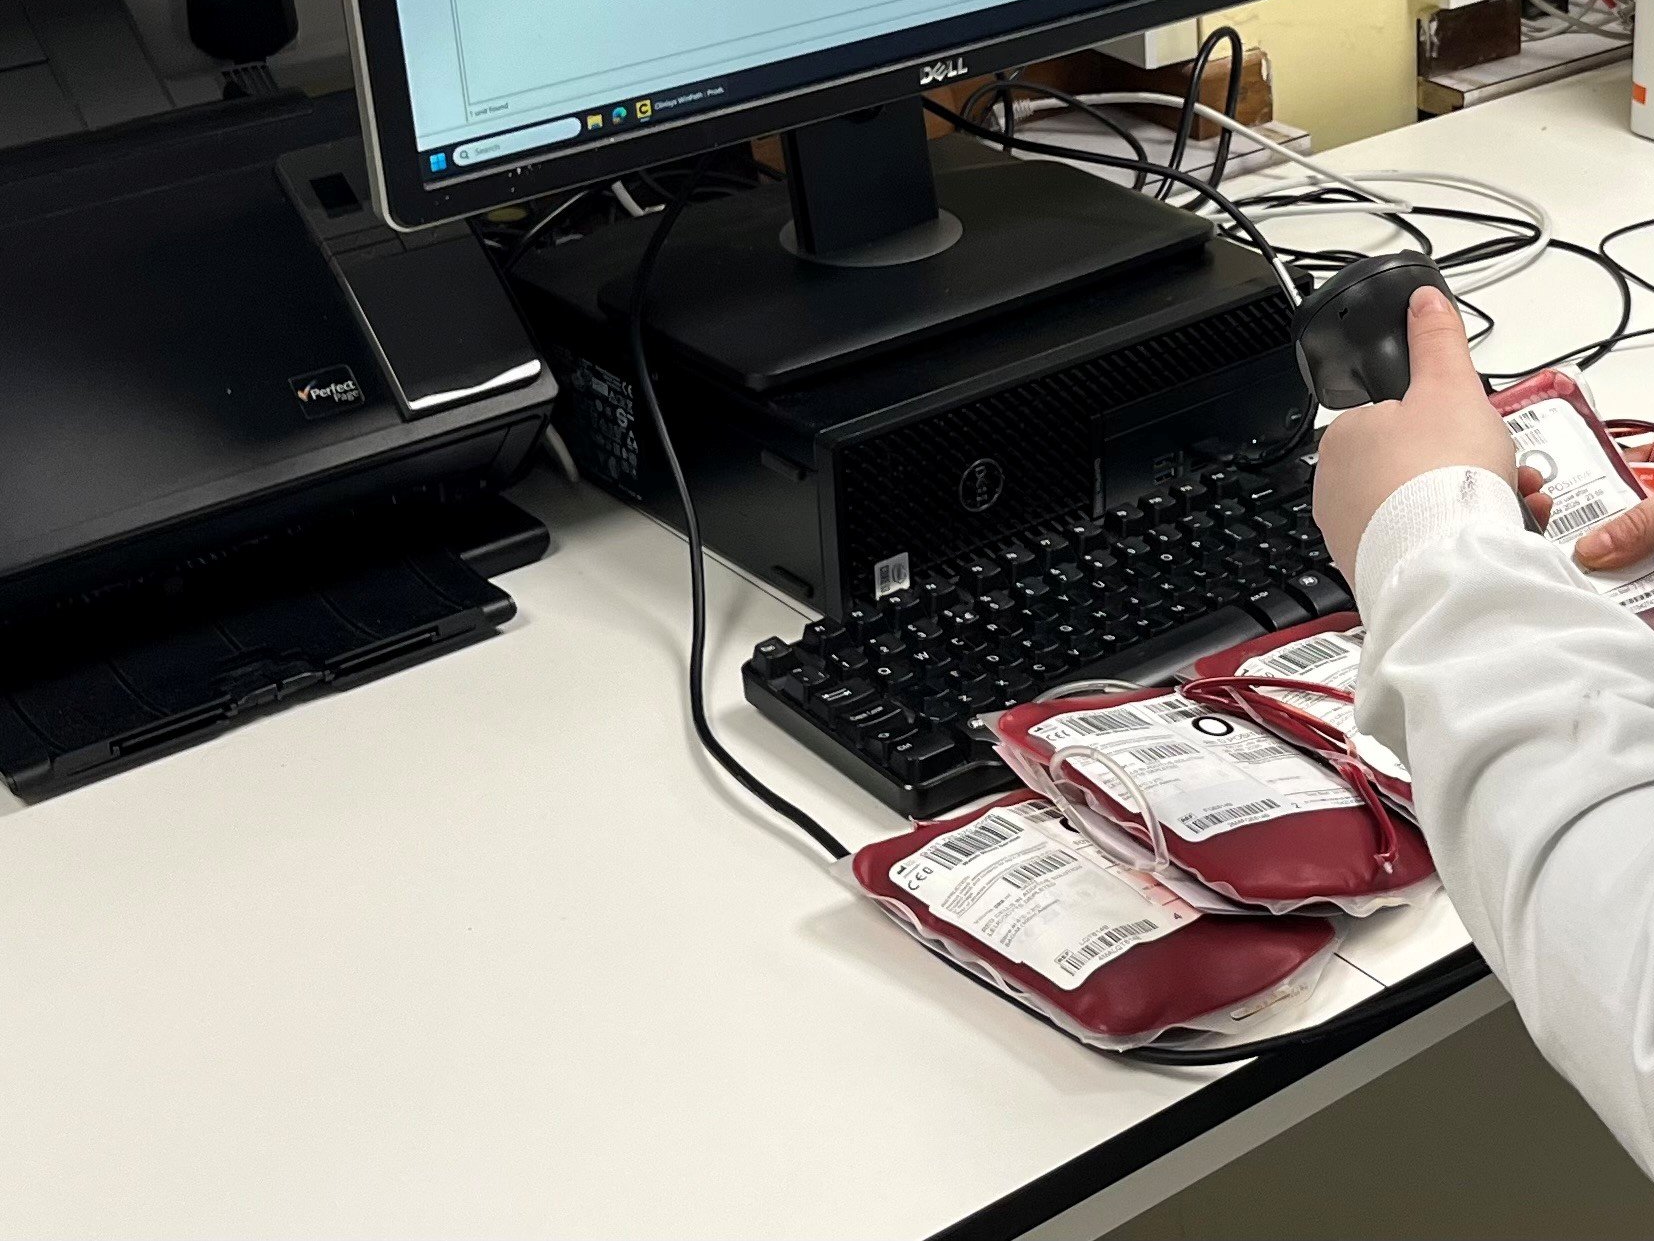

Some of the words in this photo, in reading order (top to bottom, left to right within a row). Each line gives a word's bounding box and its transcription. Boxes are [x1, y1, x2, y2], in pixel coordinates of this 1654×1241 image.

[920, 57, 968, 85] DELL
[310, 380, 356, 403] Perfect
[1191, 715, 1235, 736] O
